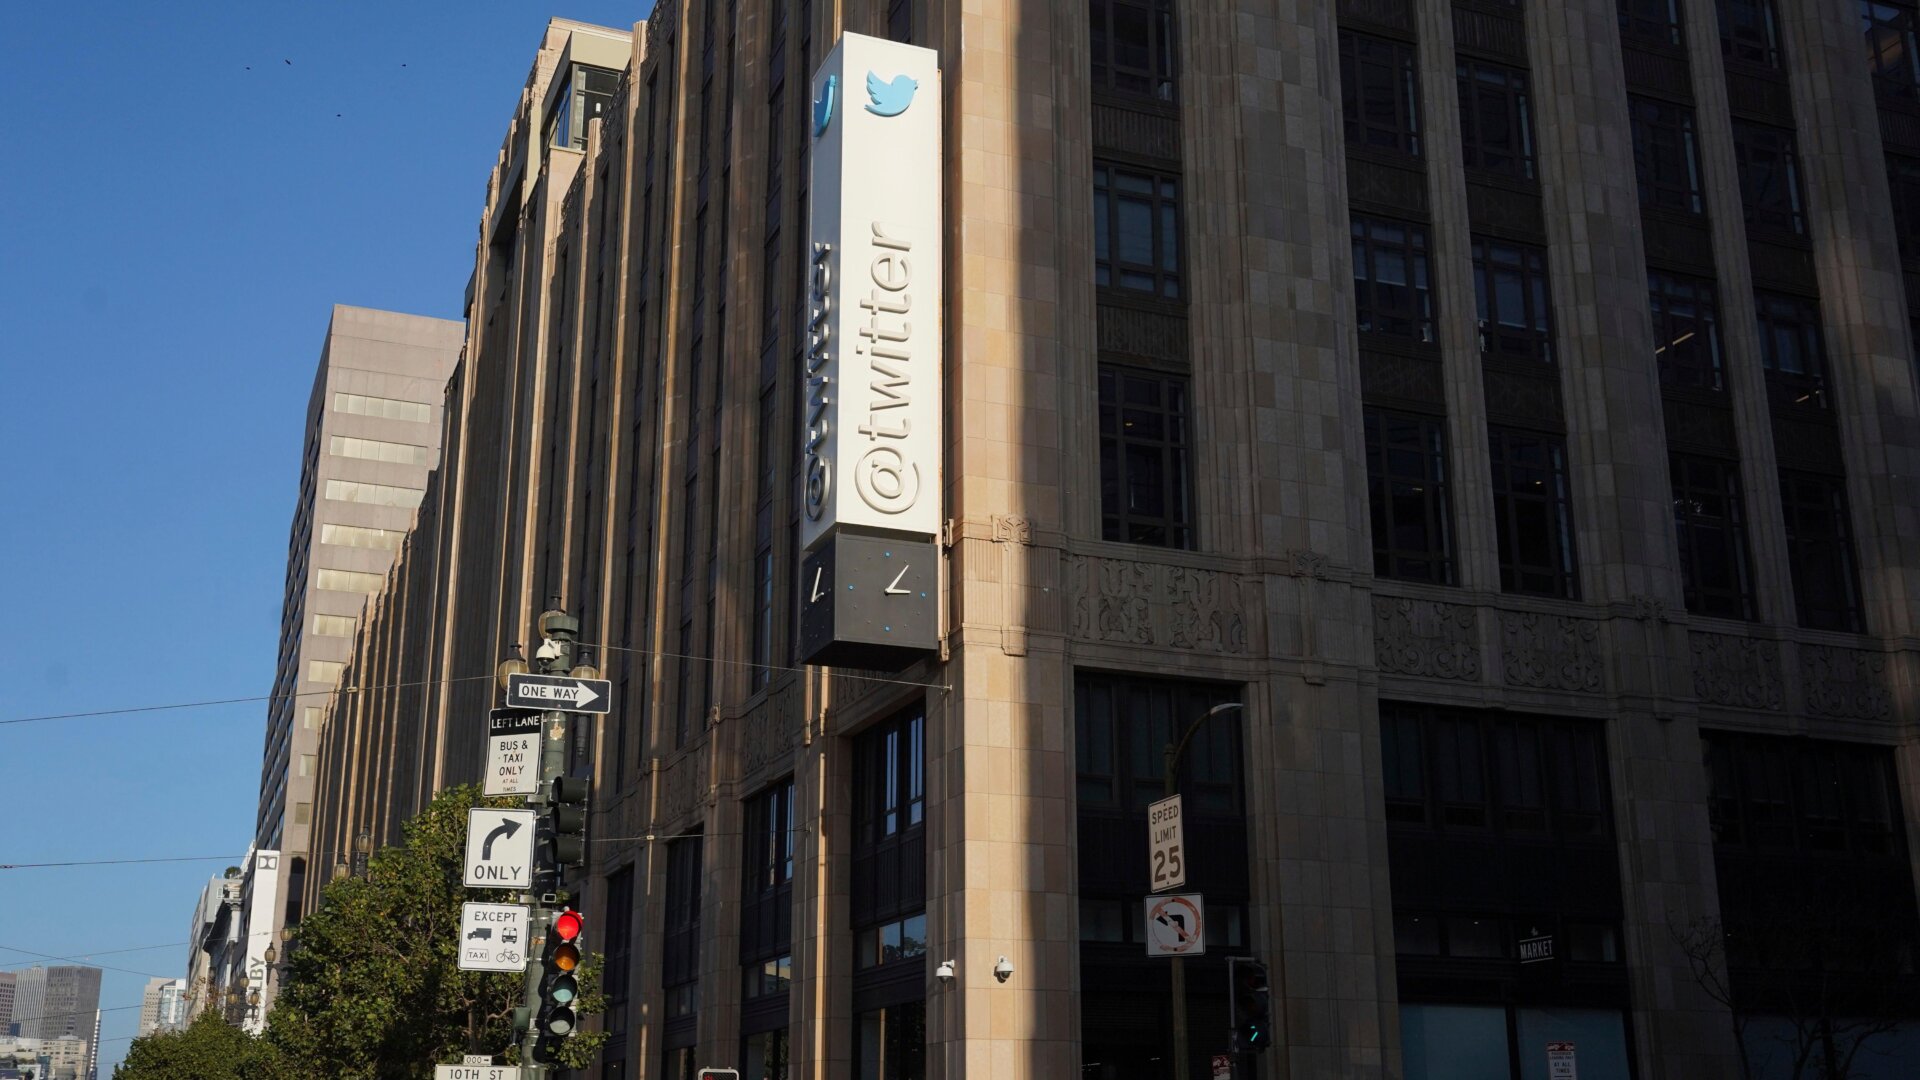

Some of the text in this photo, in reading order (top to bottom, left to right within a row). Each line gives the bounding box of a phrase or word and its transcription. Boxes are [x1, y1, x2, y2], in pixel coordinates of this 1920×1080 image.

[854, 221, 920, 514] @twitter
[522, 686, 578, 699] ONE WAY
[492, 716, 540, 728] LEFT LANE
[500, 740, 528, 751] BUS &
[504, 754, 522, 763] TAXI
[499, 766, 524, 776] ONLY
[1152, 805, 1179, 825] SPEED
[1155, 826, 1177, 844] LIMIT
[1154, 846, 1181, 882] 25
[475, 865, 522, 880] ONLY
[475, 911, 517, 922] EXCEPT
[1520, 939, 1552, 959] MARKET
[450, 1069, 503, 1080] 10TH ST
